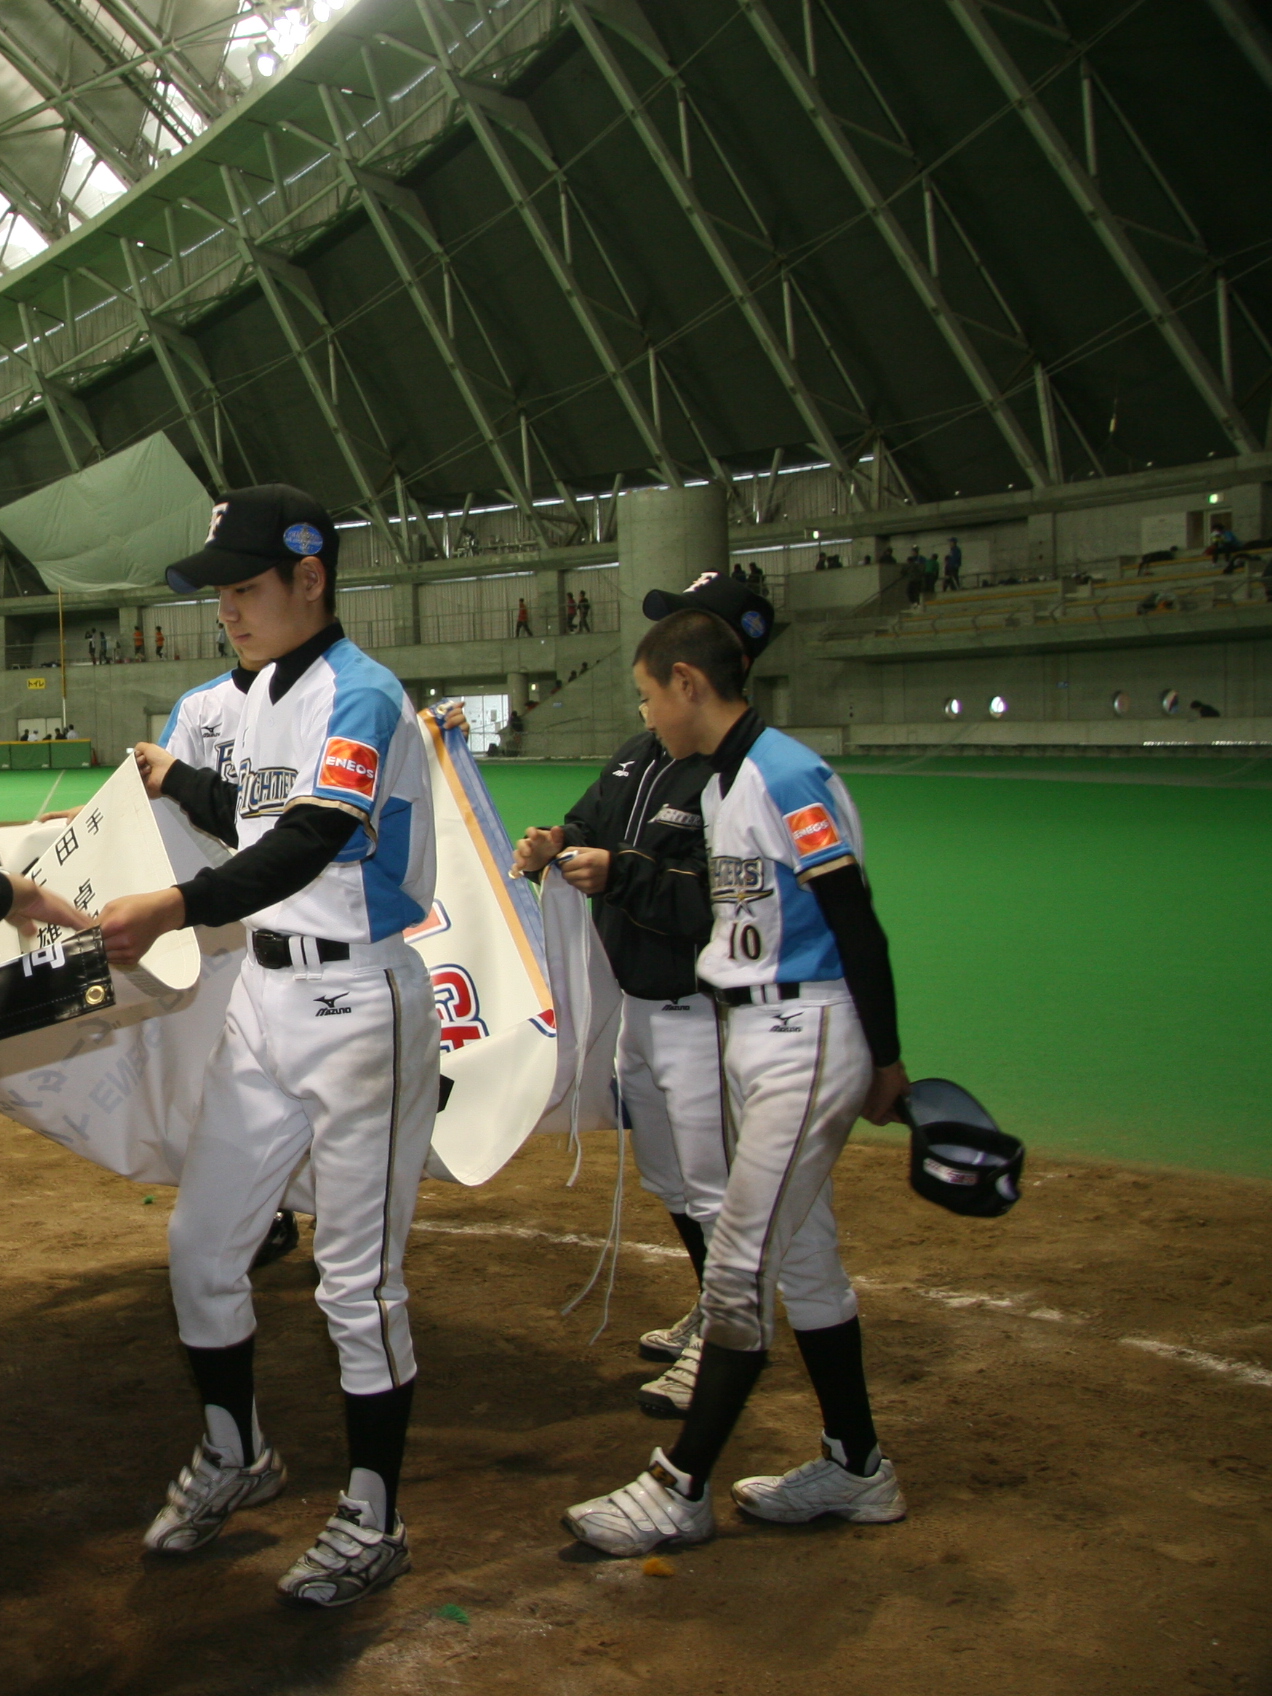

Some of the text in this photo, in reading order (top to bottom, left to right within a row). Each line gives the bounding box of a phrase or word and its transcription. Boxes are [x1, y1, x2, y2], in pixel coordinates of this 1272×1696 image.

[325, 755, 375, 780] ENEOS
[55, 826, 79, 866] 田
[793, 820, 830, 841] ENEOS
[728, 922, 762, 961] 10
